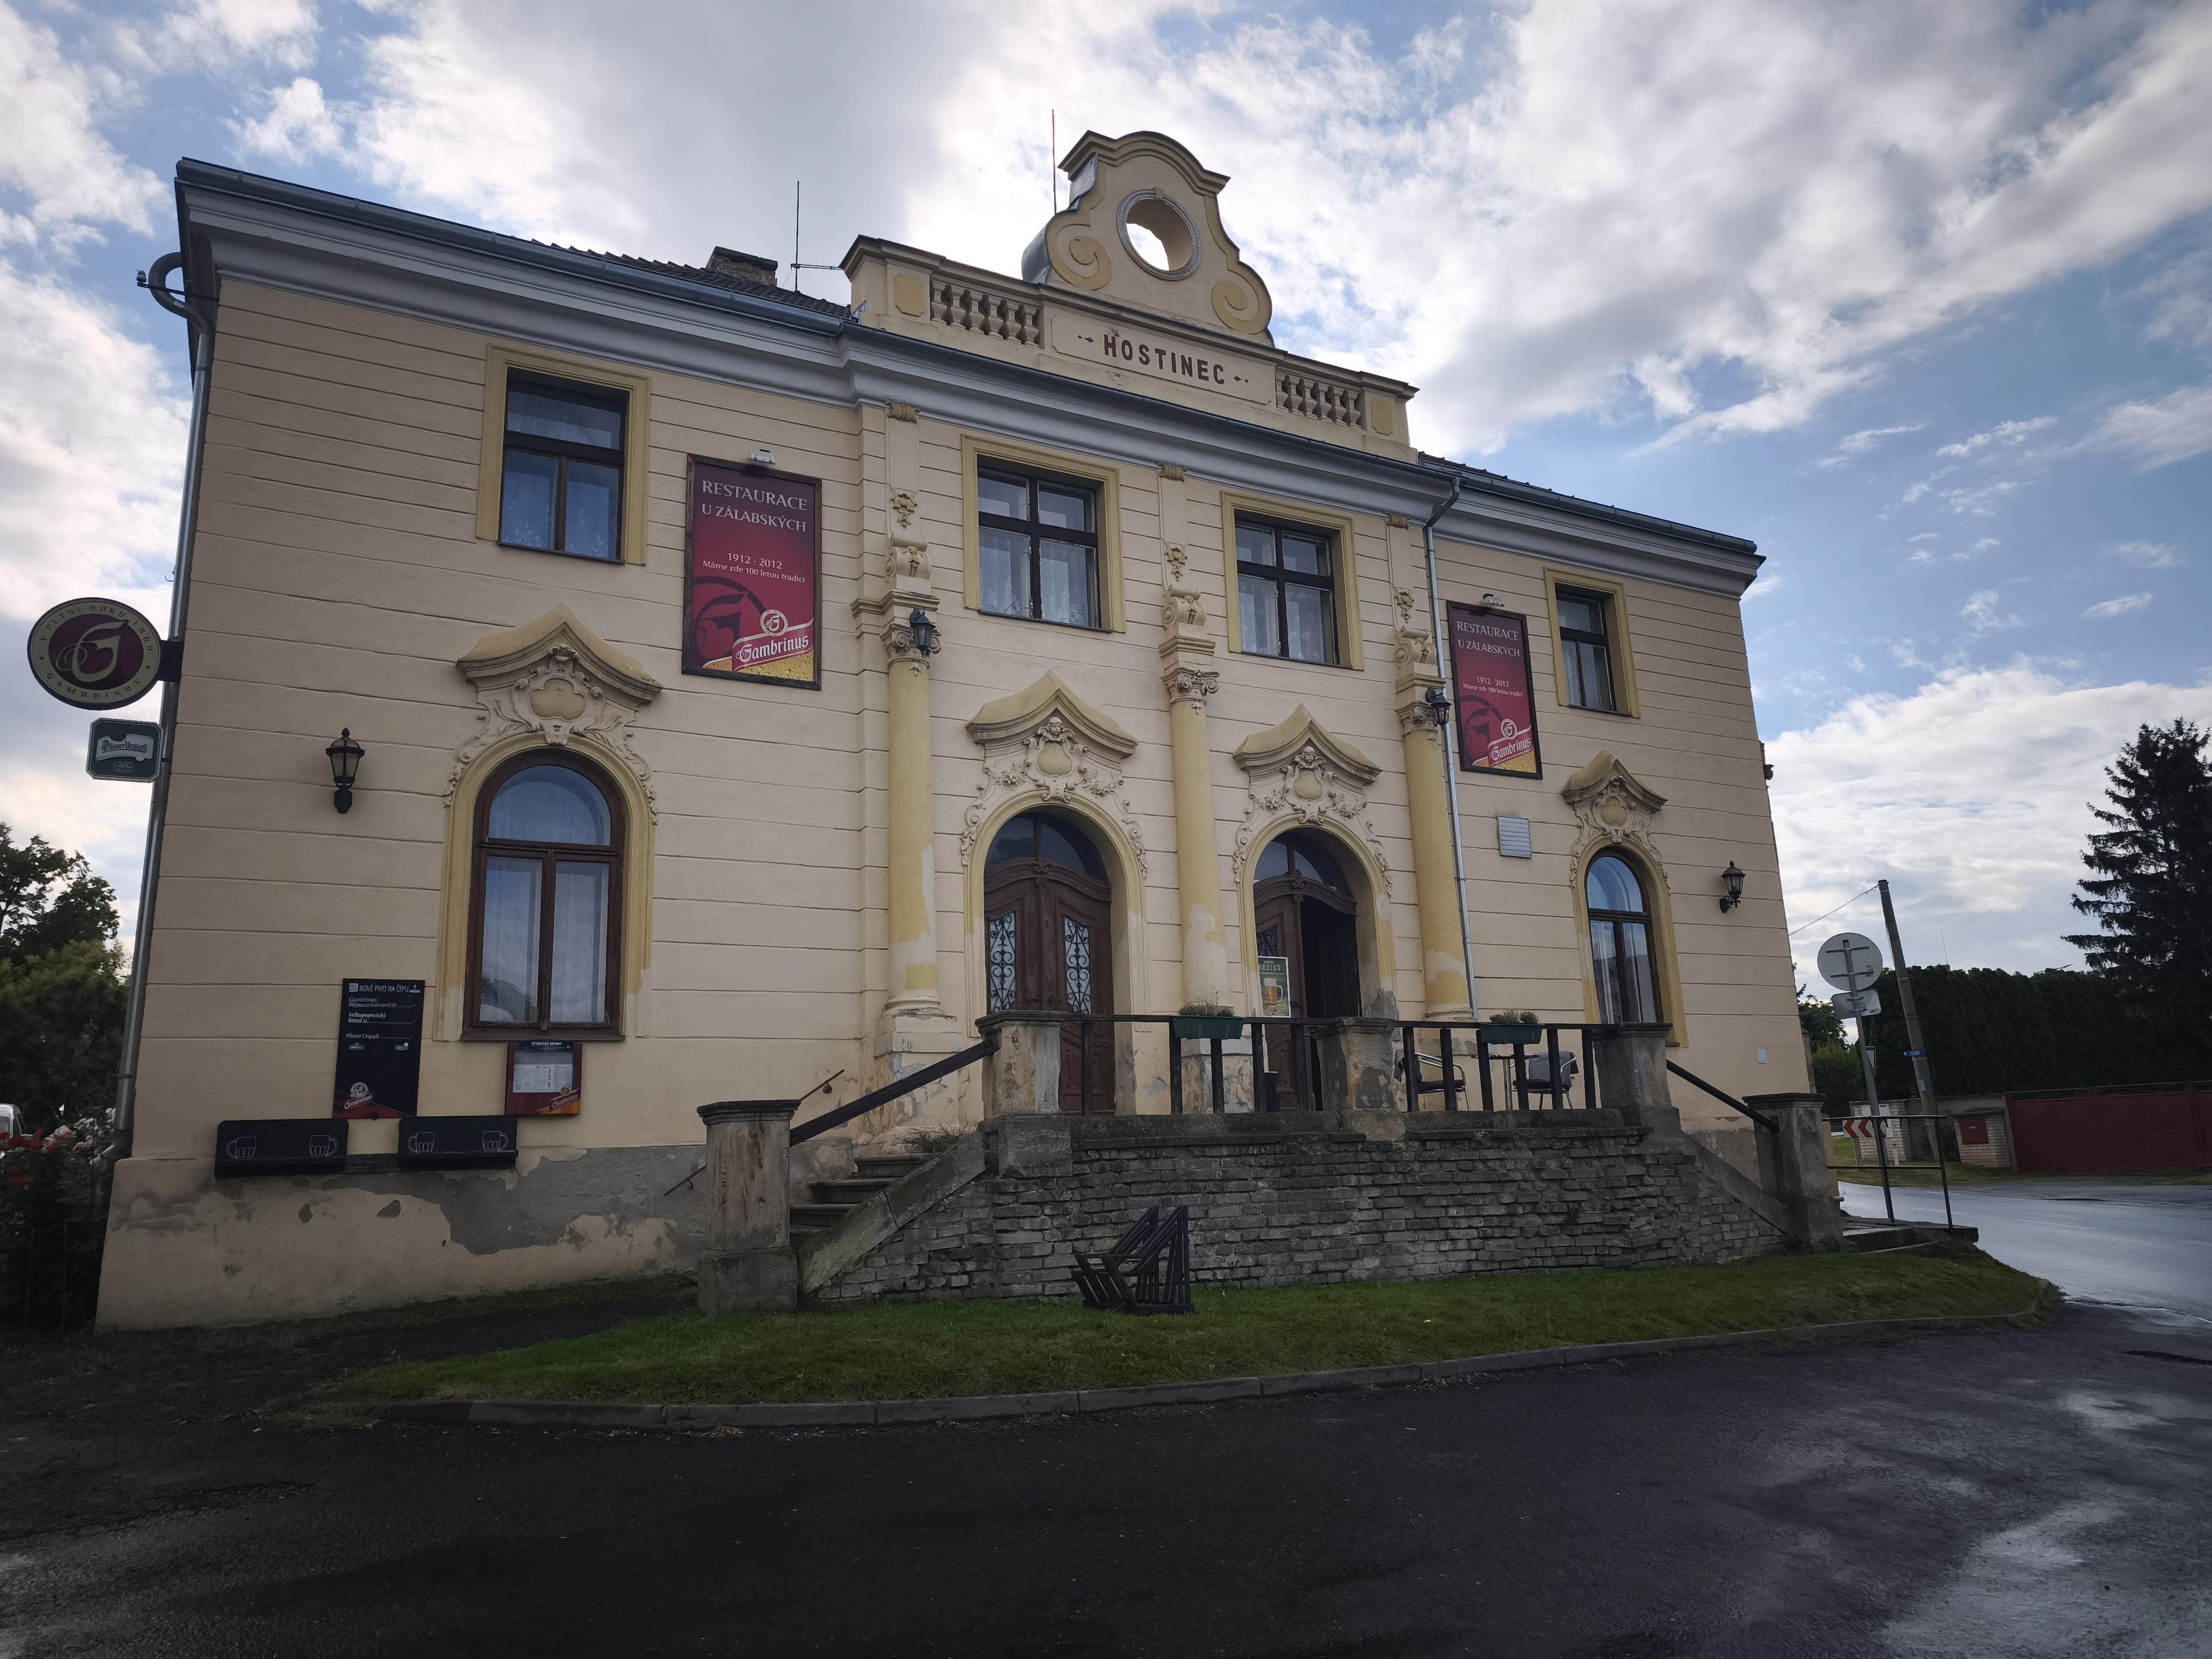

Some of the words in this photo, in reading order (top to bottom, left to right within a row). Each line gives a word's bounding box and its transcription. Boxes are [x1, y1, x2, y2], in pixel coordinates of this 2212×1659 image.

[1104, 334, 1224, 384] HOSTINEC
[702, 480, 807, 510] RESTAURACE
[702, 503, 711, 515] U
[716, 505, 806, 532] ZÁLABSKÝCH
[703, 560, 728, 570] Máme
[760, 570, 779, 579] letou
[728, 553, 750, 564] 1912
[759, 558, 782, 569] 2012
[45, 606, 81, 631] PLZNI
[90, 604, 126, 618] ROKU
[132, 621, 154, 651] 1869
[1456, 620, 1519, 640] RESTAURACE
[735, 635, 809, 663] Gambrinus
[1458, 639, 1465, 648] U
[1467, 640, 1520, 658] ZÁLABSKÝCH
[46, 672, 142, 699] GAMBRINUS
[1477, 676, 1491, 685] 1912
[1495, 679, 1509, 687] 2012
[102, 740, 126, 753] Pilsner
[125, 740, 148, 752] Urquell
[1490, 738, 1531, 760] Gambrinus
[359, 983, 373, 992] NOVÉ
[397, 984, 409, 993] ČEPU
[344, 1094, 373, 1109] Gambrinus
